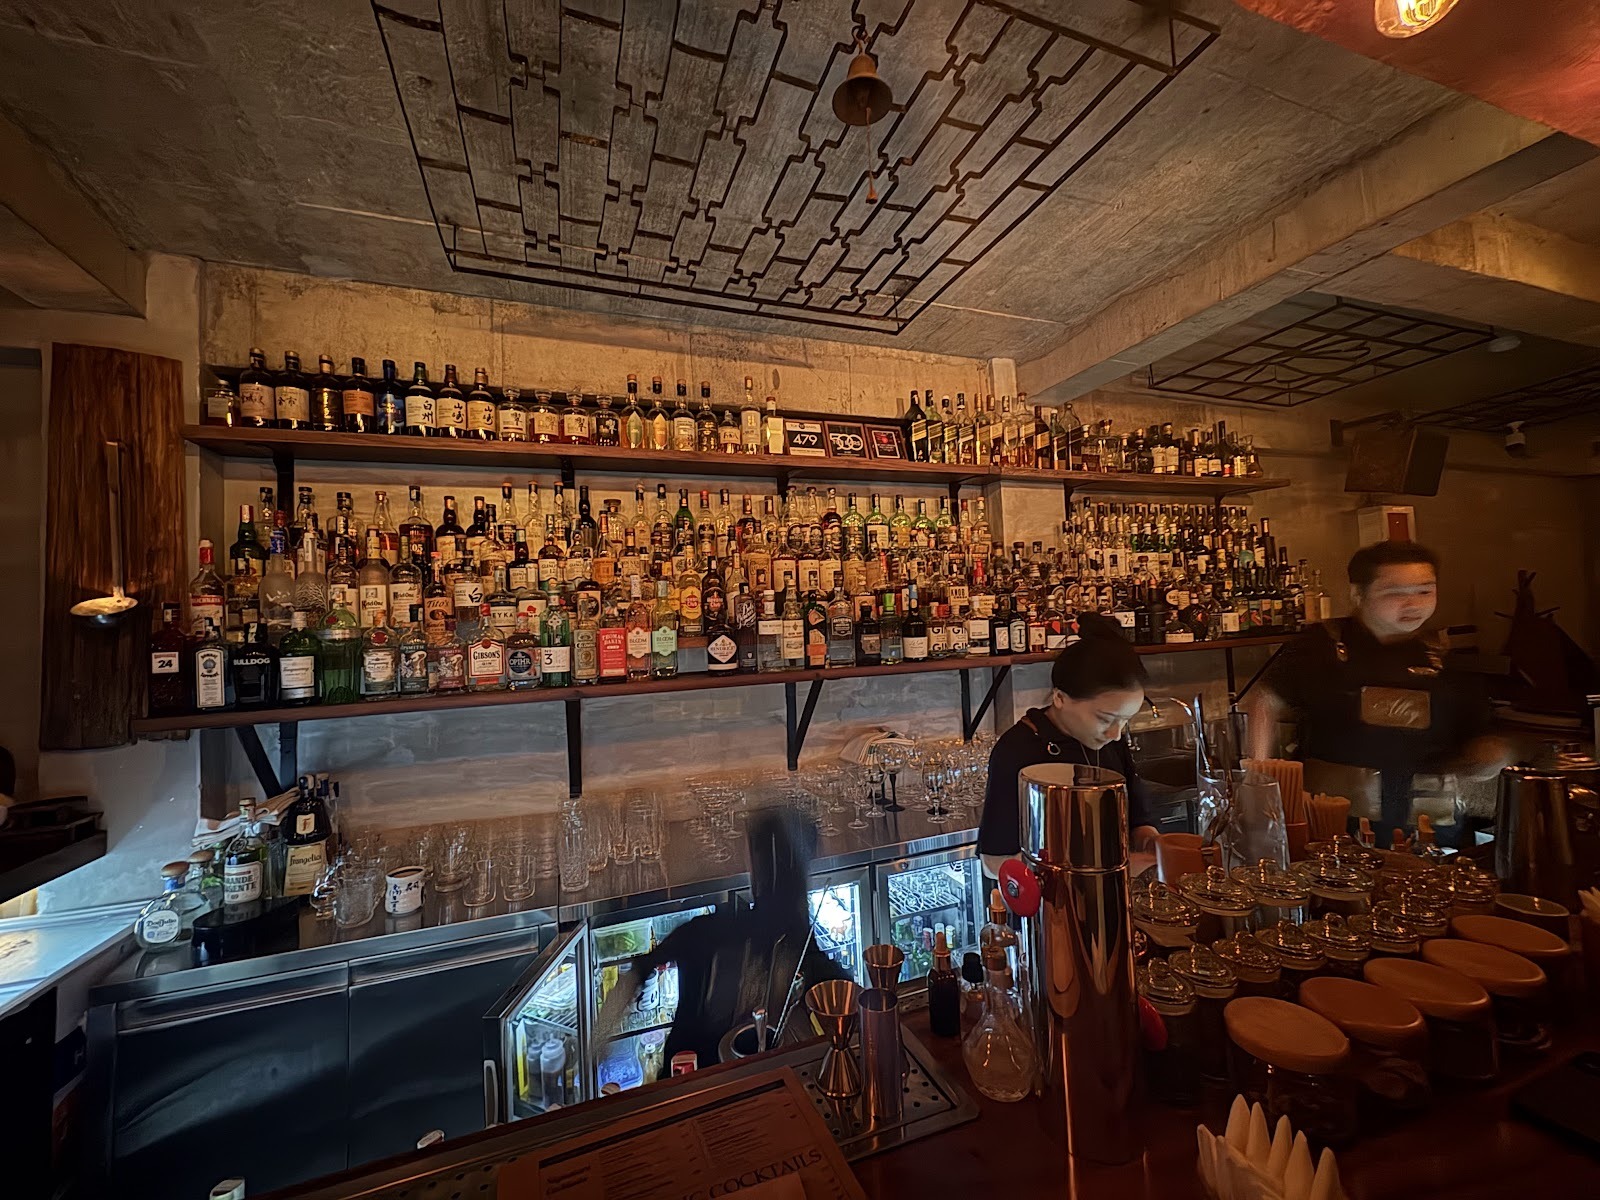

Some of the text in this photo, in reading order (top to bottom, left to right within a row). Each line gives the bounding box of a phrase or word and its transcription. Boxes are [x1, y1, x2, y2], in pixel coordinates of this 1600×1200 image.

[793, 434, 818, 446] 479
[427, 600, 449, 608] Tito's
[473, 651, 501, 660] GIBSON'S
[544, 653, 553, 665] 3
[158, 660, 172, 668] 24
[233, 657, 271, 666] BULLDOG
[225, 874, 254, 885] RANDE
[225, 882, 257, 892] SENTE
[709, 1148, 822, 1199] COCKTAILS
